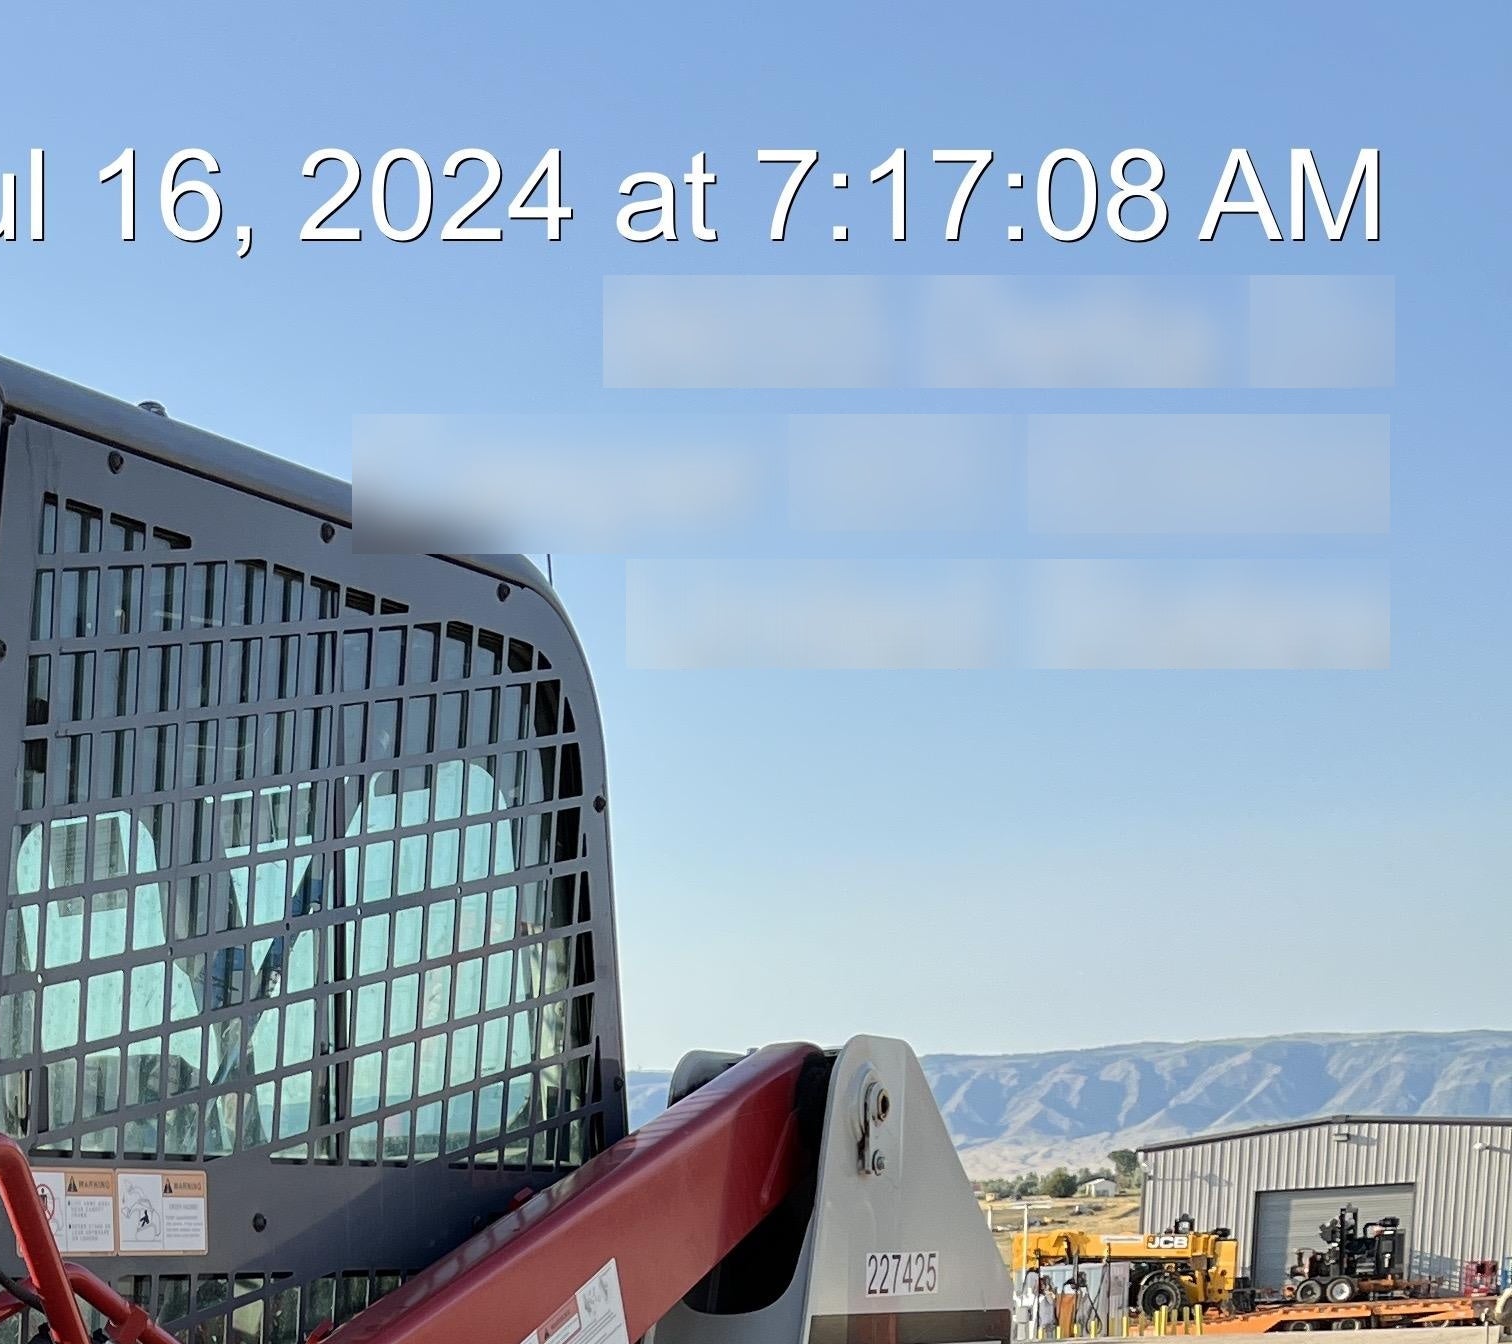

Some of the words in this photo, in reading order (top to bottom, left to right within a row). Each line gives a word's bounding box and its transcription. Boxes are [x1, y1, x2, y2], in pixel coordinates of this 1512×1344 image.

[78, 1181, 111, 1190] WARNING
[173, 1181, 202, 1190] WARNING
[1147, 1236, 1188, 1249] JCB
[868, 1253, 937, 1295] 227425
